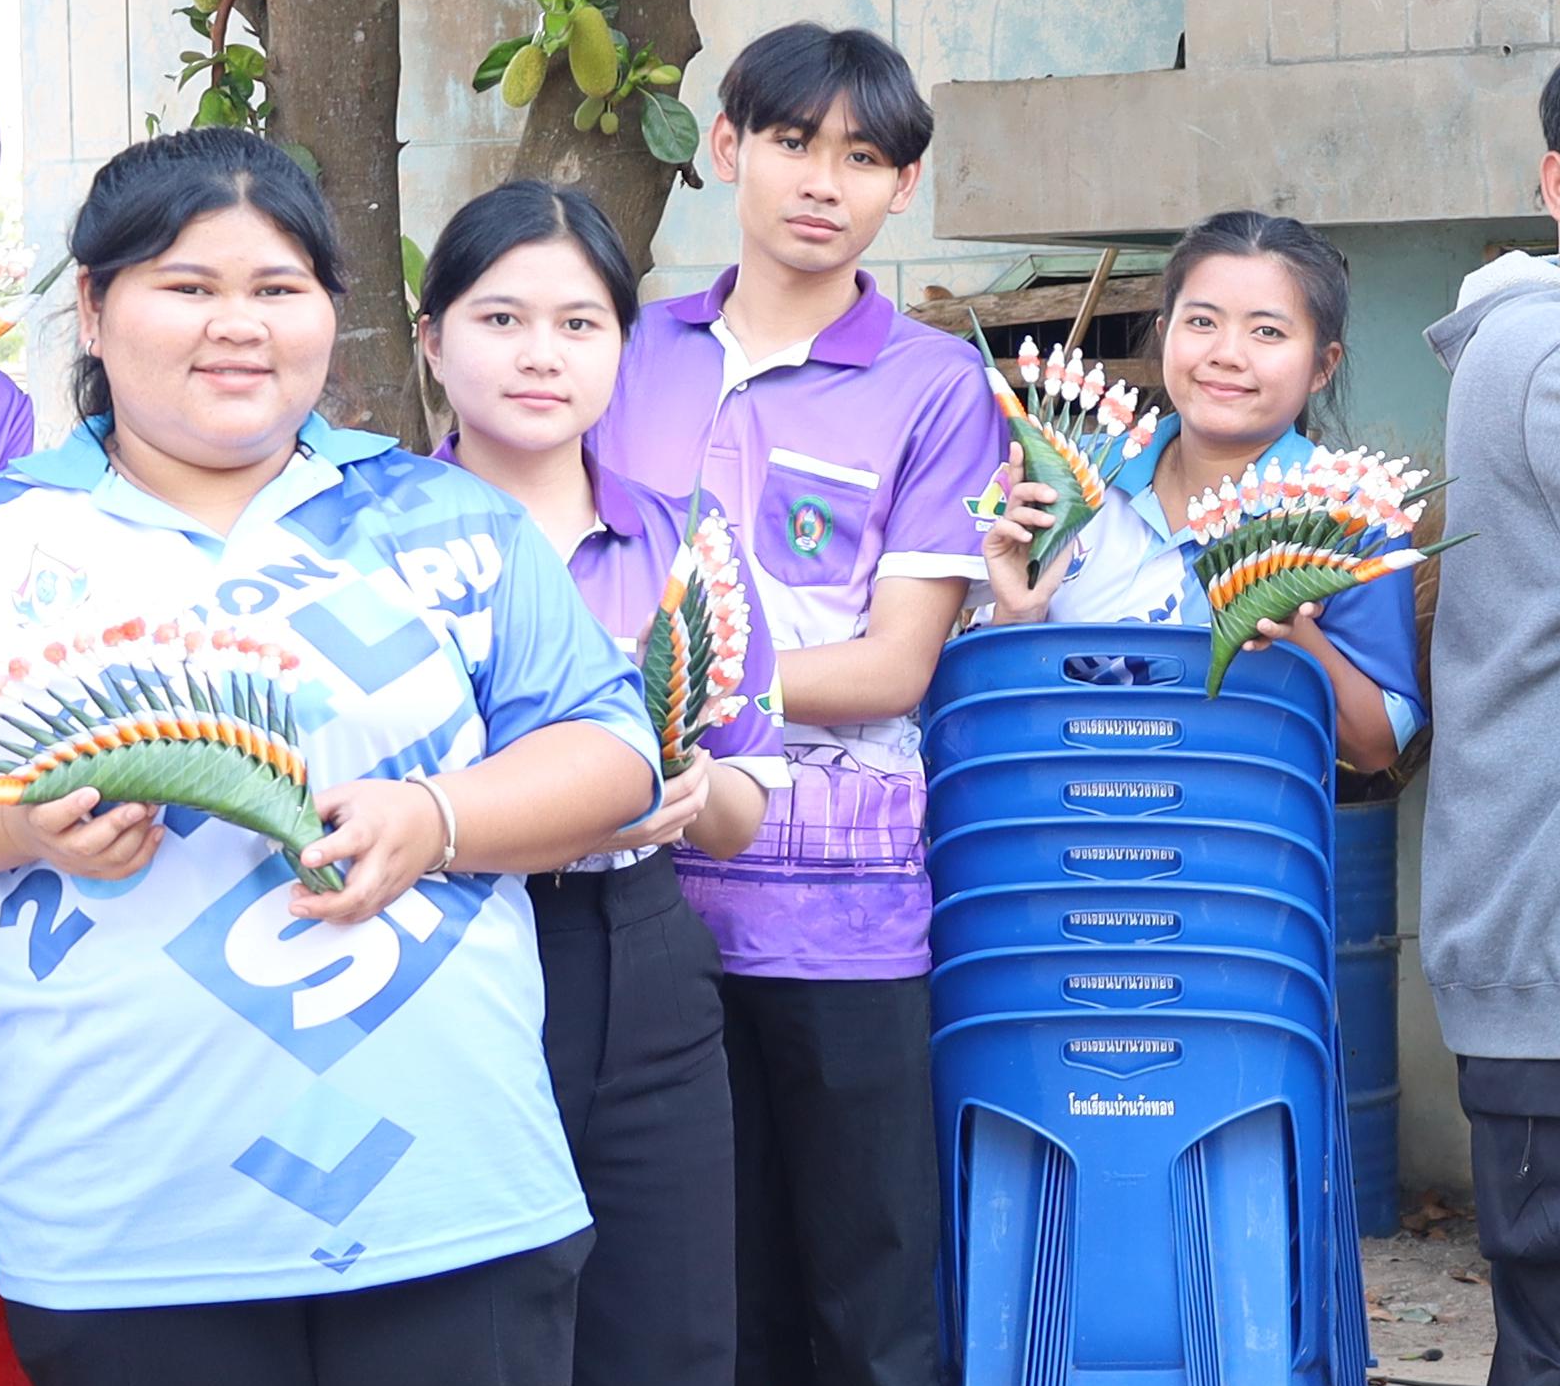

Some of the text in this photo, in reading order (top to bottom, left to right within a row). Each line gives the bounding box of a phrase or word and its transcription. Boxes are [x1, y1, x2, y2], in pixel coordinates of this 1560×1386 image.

[1068, 1092, 1175, 1116] โรงเรียนบ้านวังทอง
